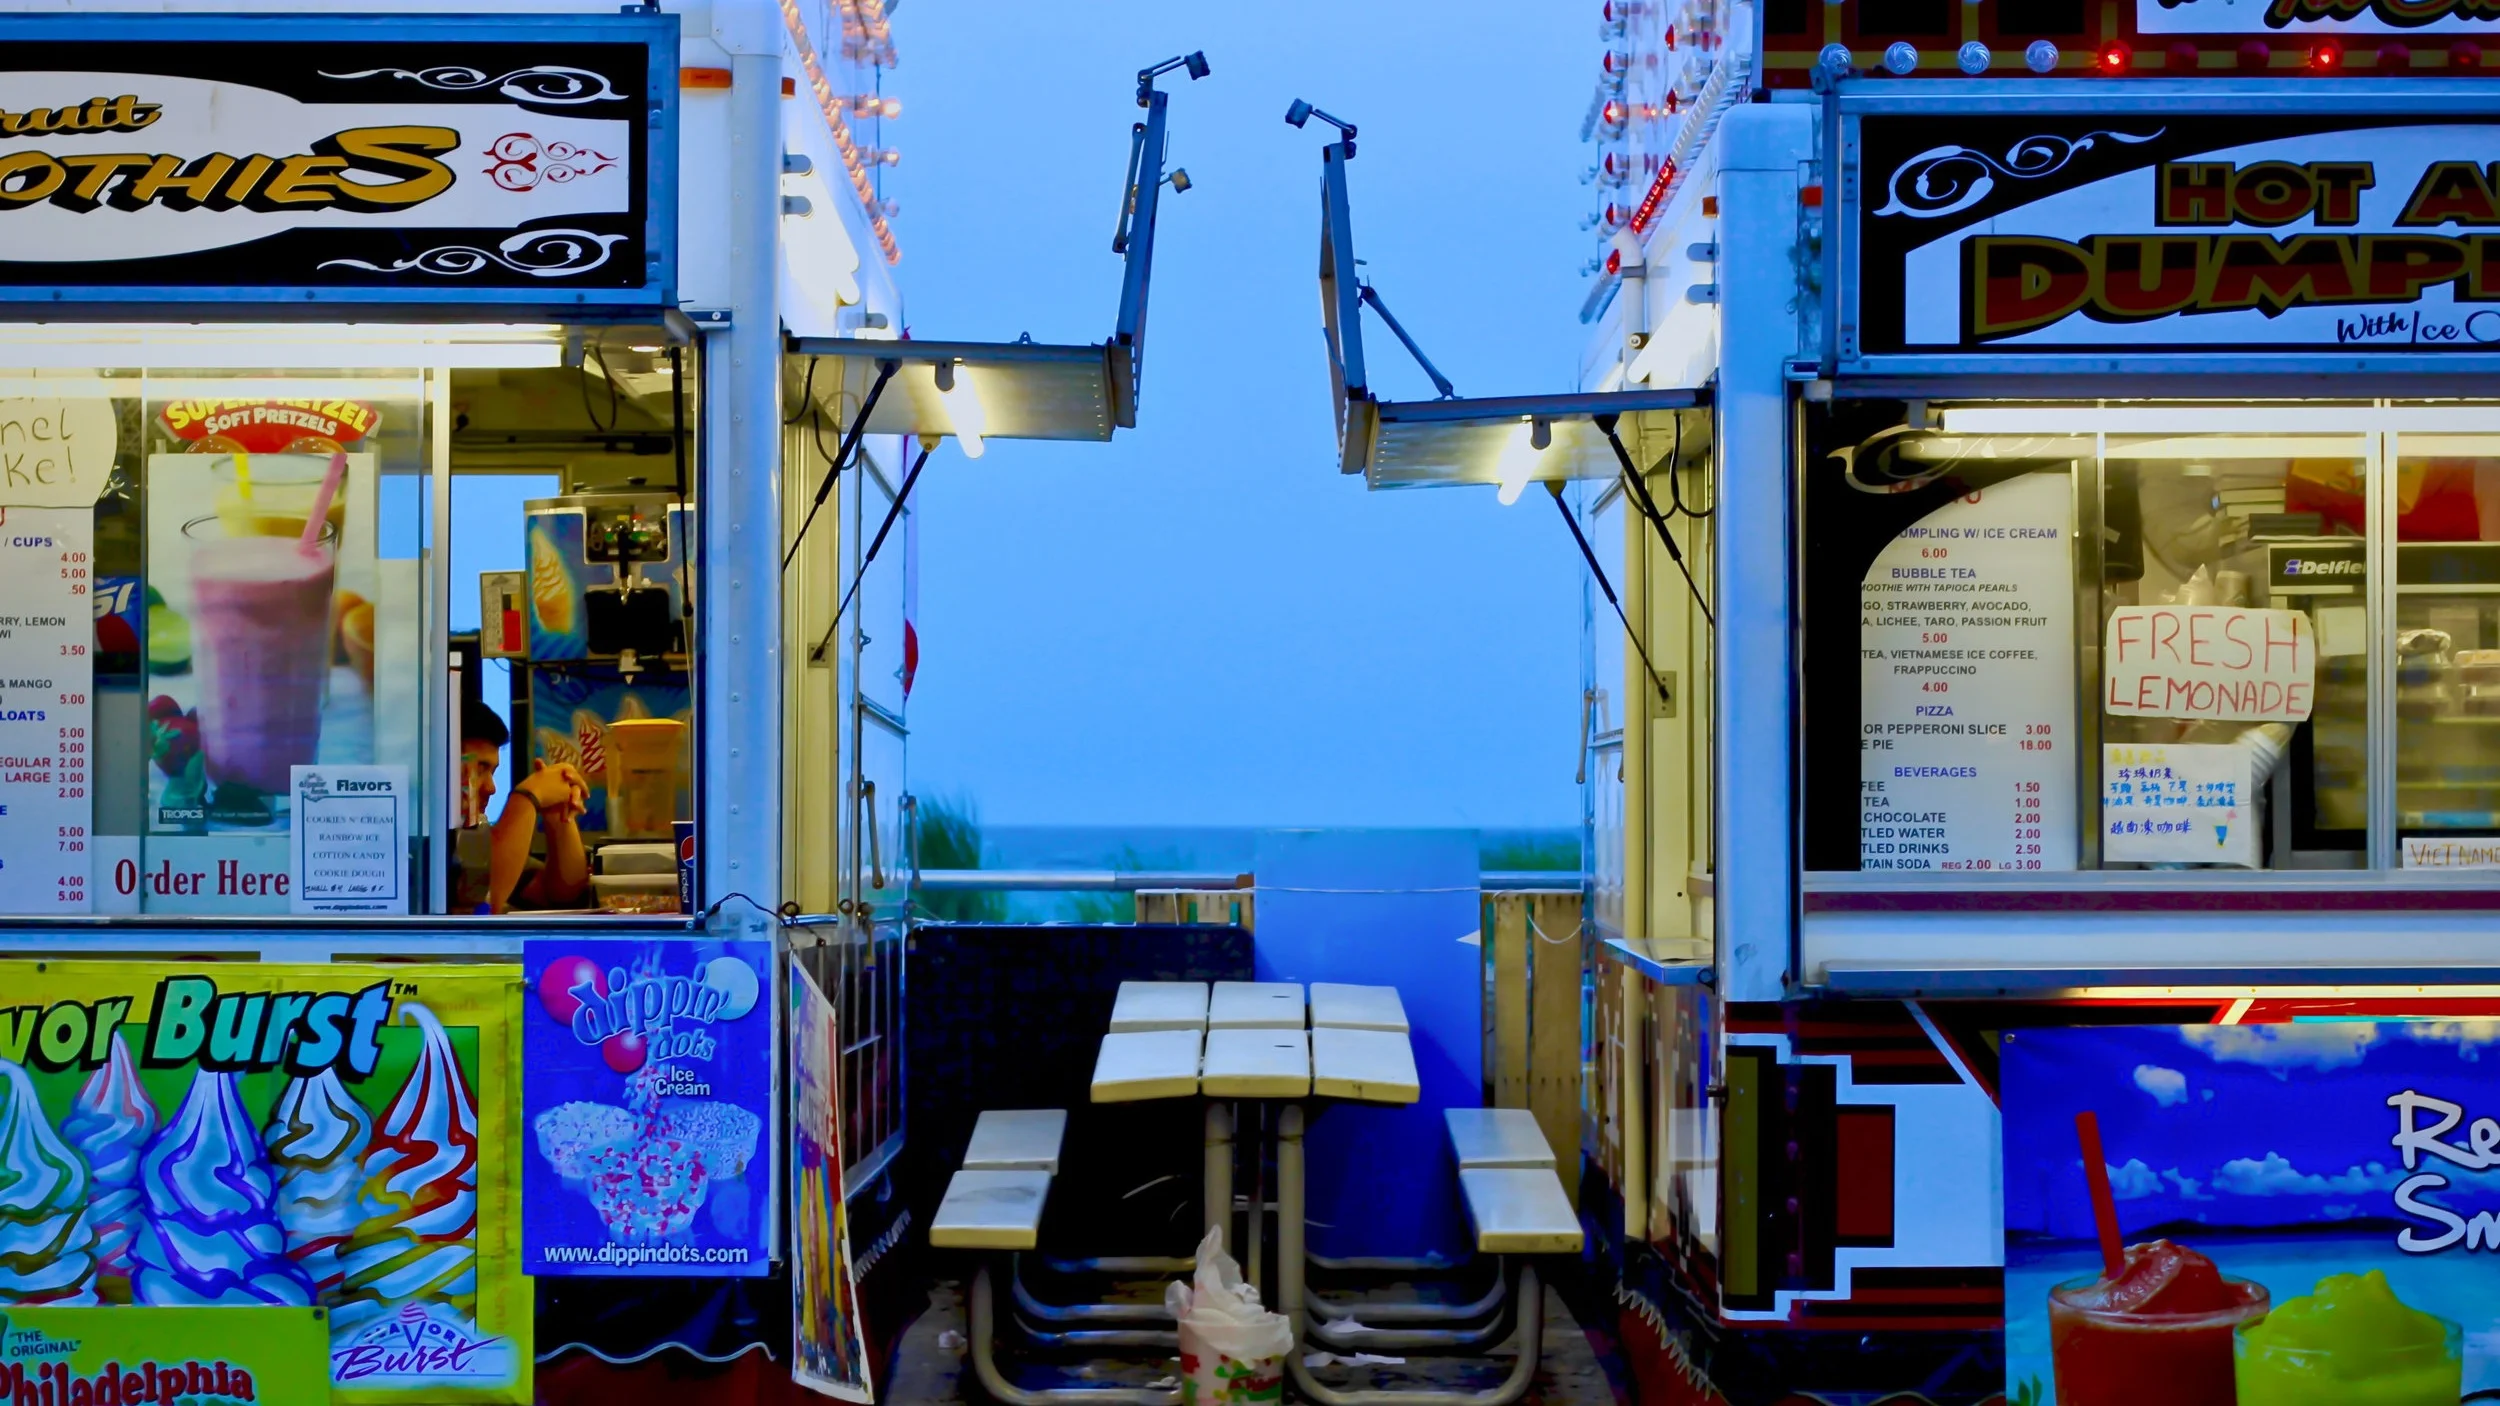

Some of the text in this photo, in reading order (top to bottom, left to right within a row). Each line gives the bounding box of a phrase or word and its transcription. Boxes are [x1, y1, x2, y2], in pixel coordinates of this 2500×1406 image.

[2154, 161, 2376, 227] HOT
[2337, 312, 2409, 343] With
[2411, 311, 2460, 344] Ice
[204, 407, 338, 436] SOFT PRETZELS
[1900, 528, 2058, 540] UMPLING W/ ICE CREAM
[13, 537, 53, 547] CUPS
[60, 552, 86, 563] 4.00
[1921, 548, 1948, 559] 6.00
[61, 568, 86, 579] 5.00
[1891, 568, 1977, 579] BUBBLE TEA
[68, 584, 86, 595] .50
[1905, 584, 1931, 592] WITH
[1934, 584, 1976, 592] TAPIOCA
[1978, 584, 2018, 592] PEARLS
[1887, 601, 1968, 612] STRAWBERRY,
[1971, 601, 2031, 612] AVOCADO,
[25, 617, 66, 627] LEMON
[1876, 617, 1921, 628] LICHEE,
[1924, 617, 1959, 628] TARO,
[1961, 616, 2012, 627] PASSION
[2015, 616, 2048, 627] FRUIT
[1922, 633, 1948, 643] 5.00
[2117, 612, 2300, 673] FRESH
[60, 645, 85, 655] 3.50
[1863, 650, 2038, 661] TEA, VIETNAMESE ICE COFFEE,
[1894, 665, 1977, 675] FRAPPUCCINO
[9, 679, 53, 688] MANGO
[1922, 682, 1948, 692] 4.00
[60, 694, 85, 705] 5.00
[2110, 675, 2309, 714] LEMONADE
[1915, 706, 1954, 716] PIZZA
[59, 728, 85, 738] 5.00
[1864, 724, 2051, 735] OR PEPPERONI SLICE 3.00
[59, 743, 84, 753] 5.00
[1872, 740, 1894, 749] PIE
[2019, 740, 2052, 750] 18.00
[58, 758, 84, 768] 2.00
[1894, 766, 1977, 777] BEVERAGES
[5, 772, 84, 783] LARGE 3.00
[336, 779, 392, 791] Flavors
[2015, 783, 2040, 793] 1.50
[58, 788, 84, 798] 2.00
[1864, 797, 2040, 809] TEA 1.00
[161, 810, 204, 819] TROPICS
[361, 816, 394, 824] CREAM
[1864, 812, 2041, 824] CHOCOLATE 2.00
[58, 827, 84, 837] 5.00
[319, 833, 362, 841] RAINBOW
[1898, 828, 1945, 838] WATER
[2015, 829, 2041, 839] 2.00
[58, 842, 84, 852] 7.00
[1899, 843, 1949, 854] DRINKS
[2015, 844, 2041, 855] 2.50
[313, 851, 386, 860] COTTON CANDY
[1896, 858, 1931, 869] SODA
[1941, 861, 1962, 870] REG
[1966, 858, 1991, 870] 2.00
[1999, 861, 2011, 870] LG
[2015, 858, 2041, 870] 3.00
[217, 859, 290, 896] Here
[314, 869, 386, 877] COOKIE DOUGH
[58, 876, 84, 887] 4.00
[680, 868, 690, 904] pepsi
[58, 891, 84, 901] 5.00
[141, 975, 394, 1083] Burst
[653, 1027, 716, 1062] dots
[670, 1065, 695, 1083] Ice
[654, 1078, 711, 1096] Cream
[544, 1242, 749, 1267] www.dippindots.com
[332, 1335, 508, 1382] Burst
